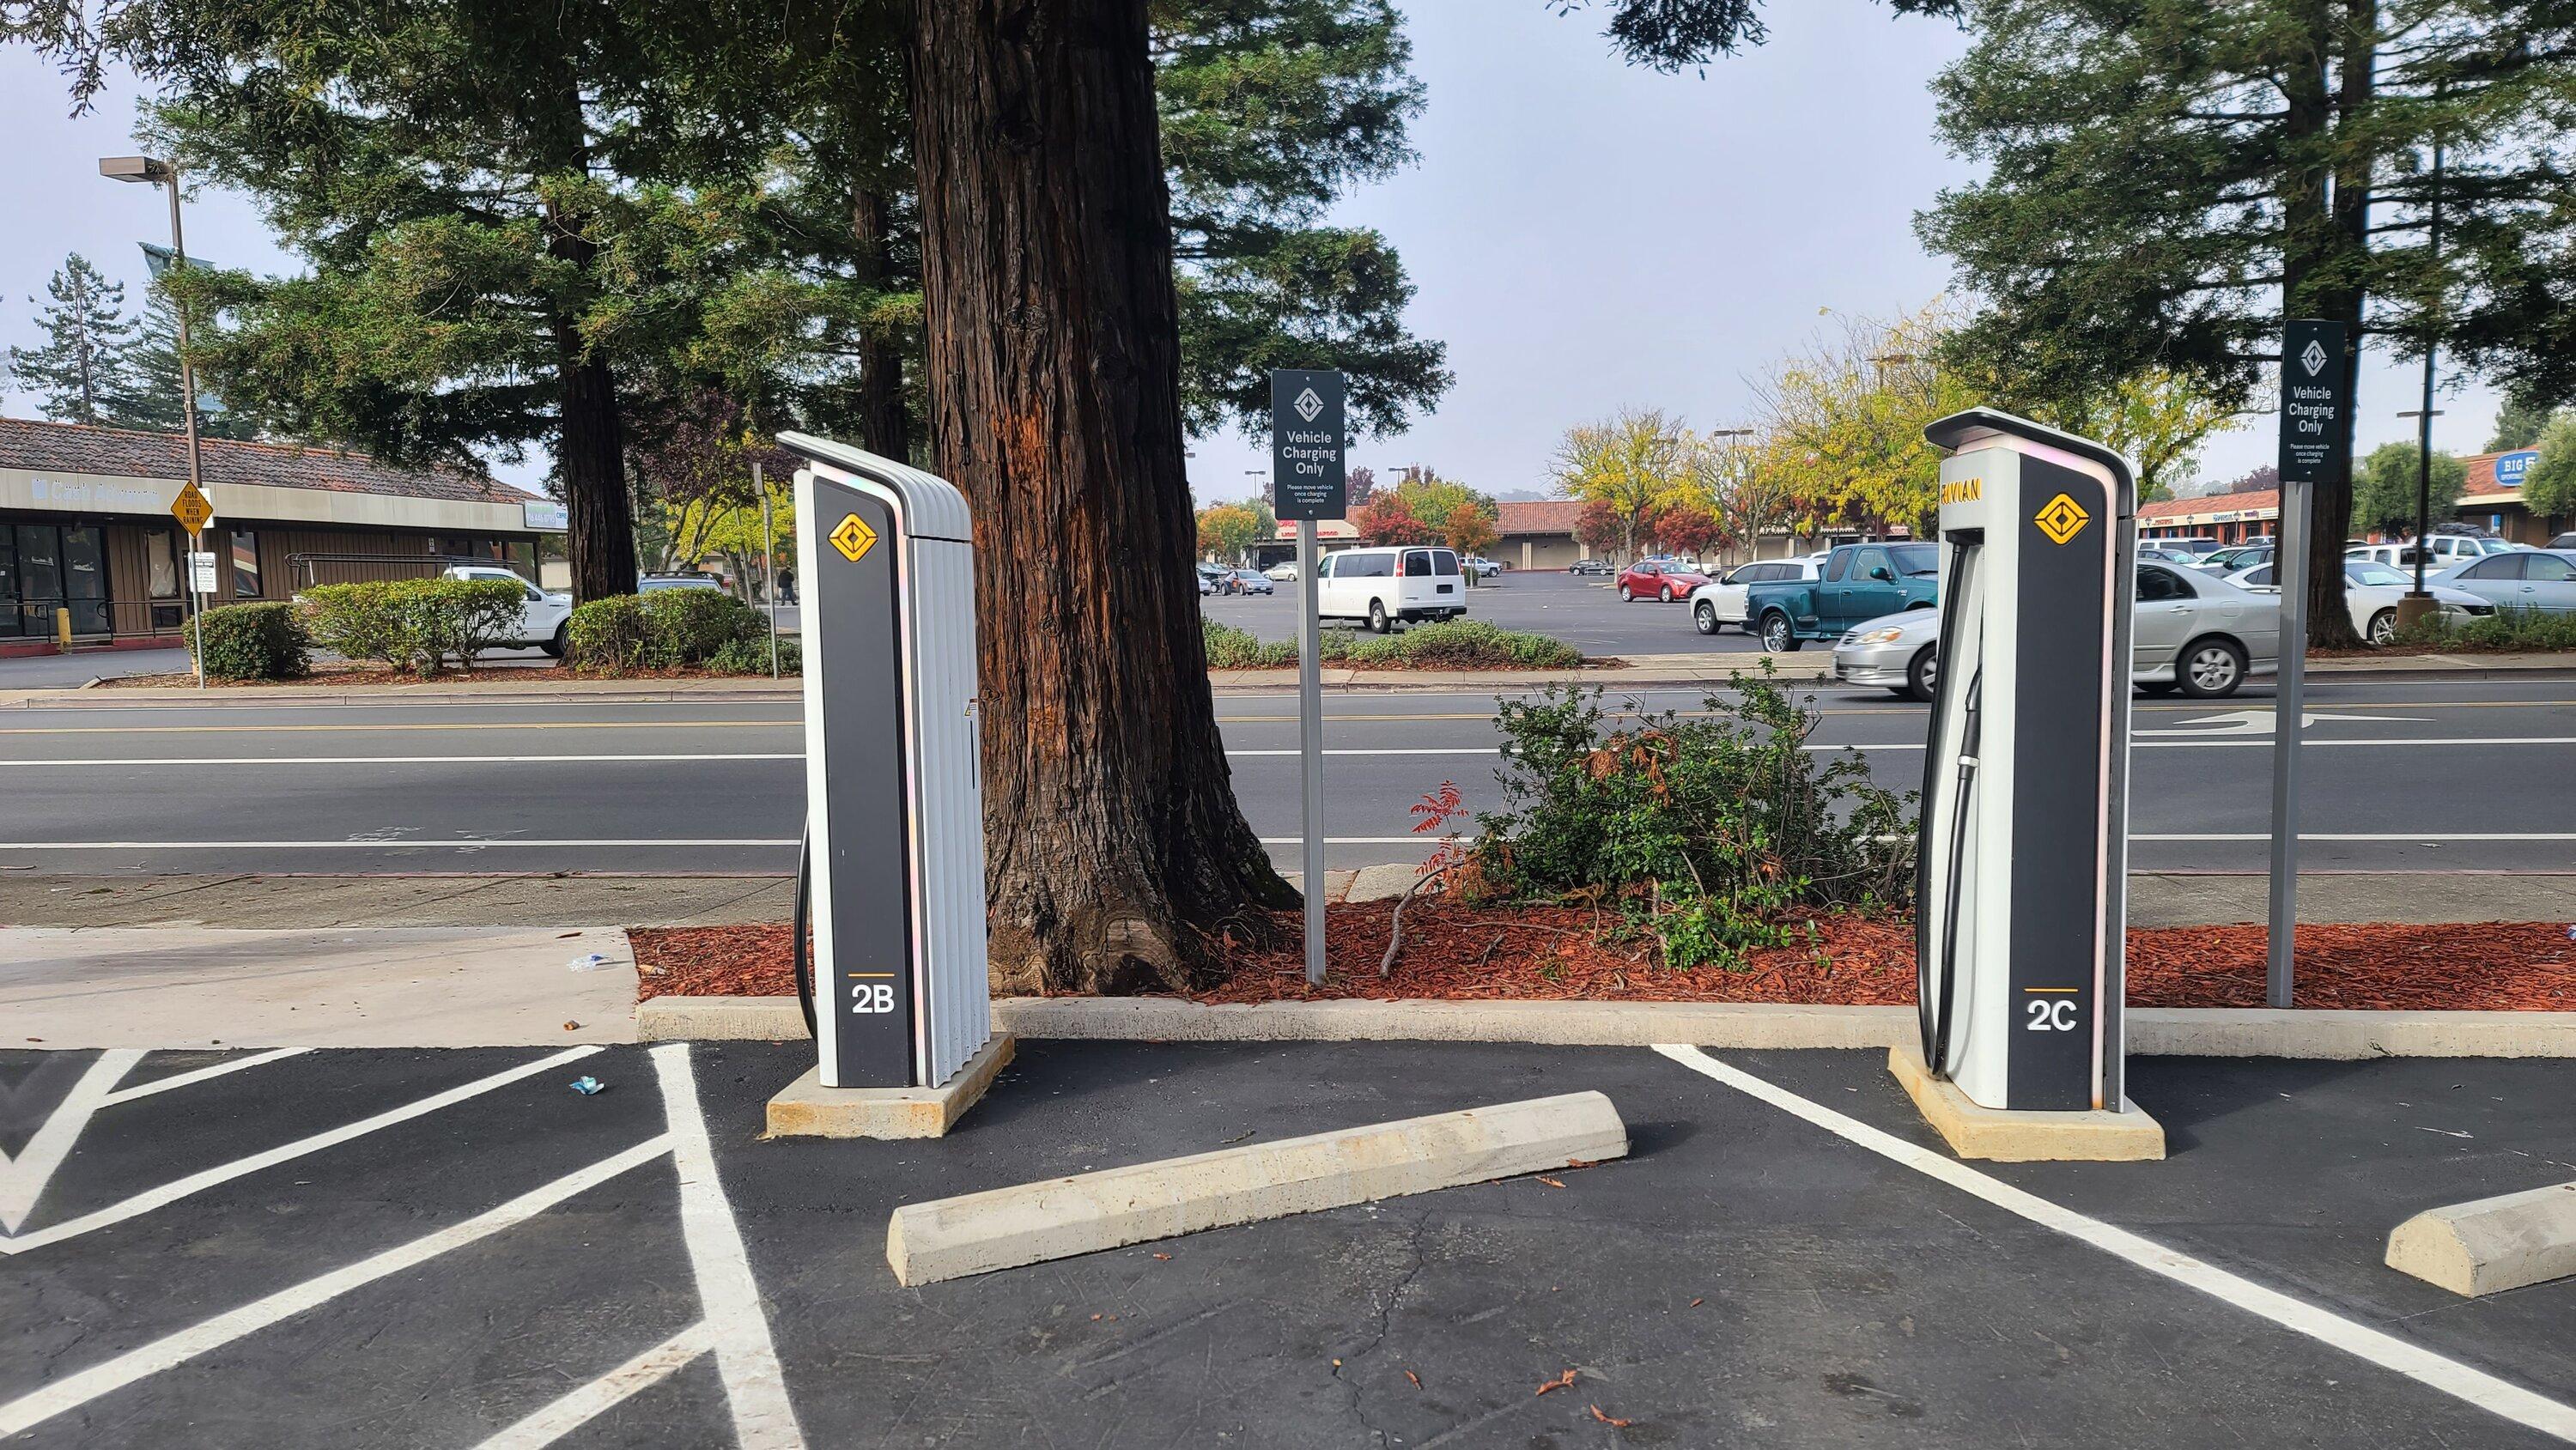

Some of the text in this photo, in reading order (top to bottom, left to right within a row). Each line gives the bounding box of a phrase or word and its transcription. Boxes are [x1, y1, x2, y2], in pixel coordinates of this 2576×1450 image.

[2293, 386, 2331, 399] Vehicle
[2288, 402, 2335, 419] Charging
[2299, 419, 2324, 435] Only
[1286, 431, 1332, 444] Vehicle
[1283, 446, 1336, 462] Charging
[1296, 462, 1324, 477] Only
[2504, 456, 2536, 472] BIG 5
[1941, 477, 1982, 505] RIVIAN
[182, 499, 201, 508] FLOODS
[182, 516, 203, 524] RAINING
[851, 984, 895, 1013] 2B
[2027, 1000, 2077, 1031] 2C
